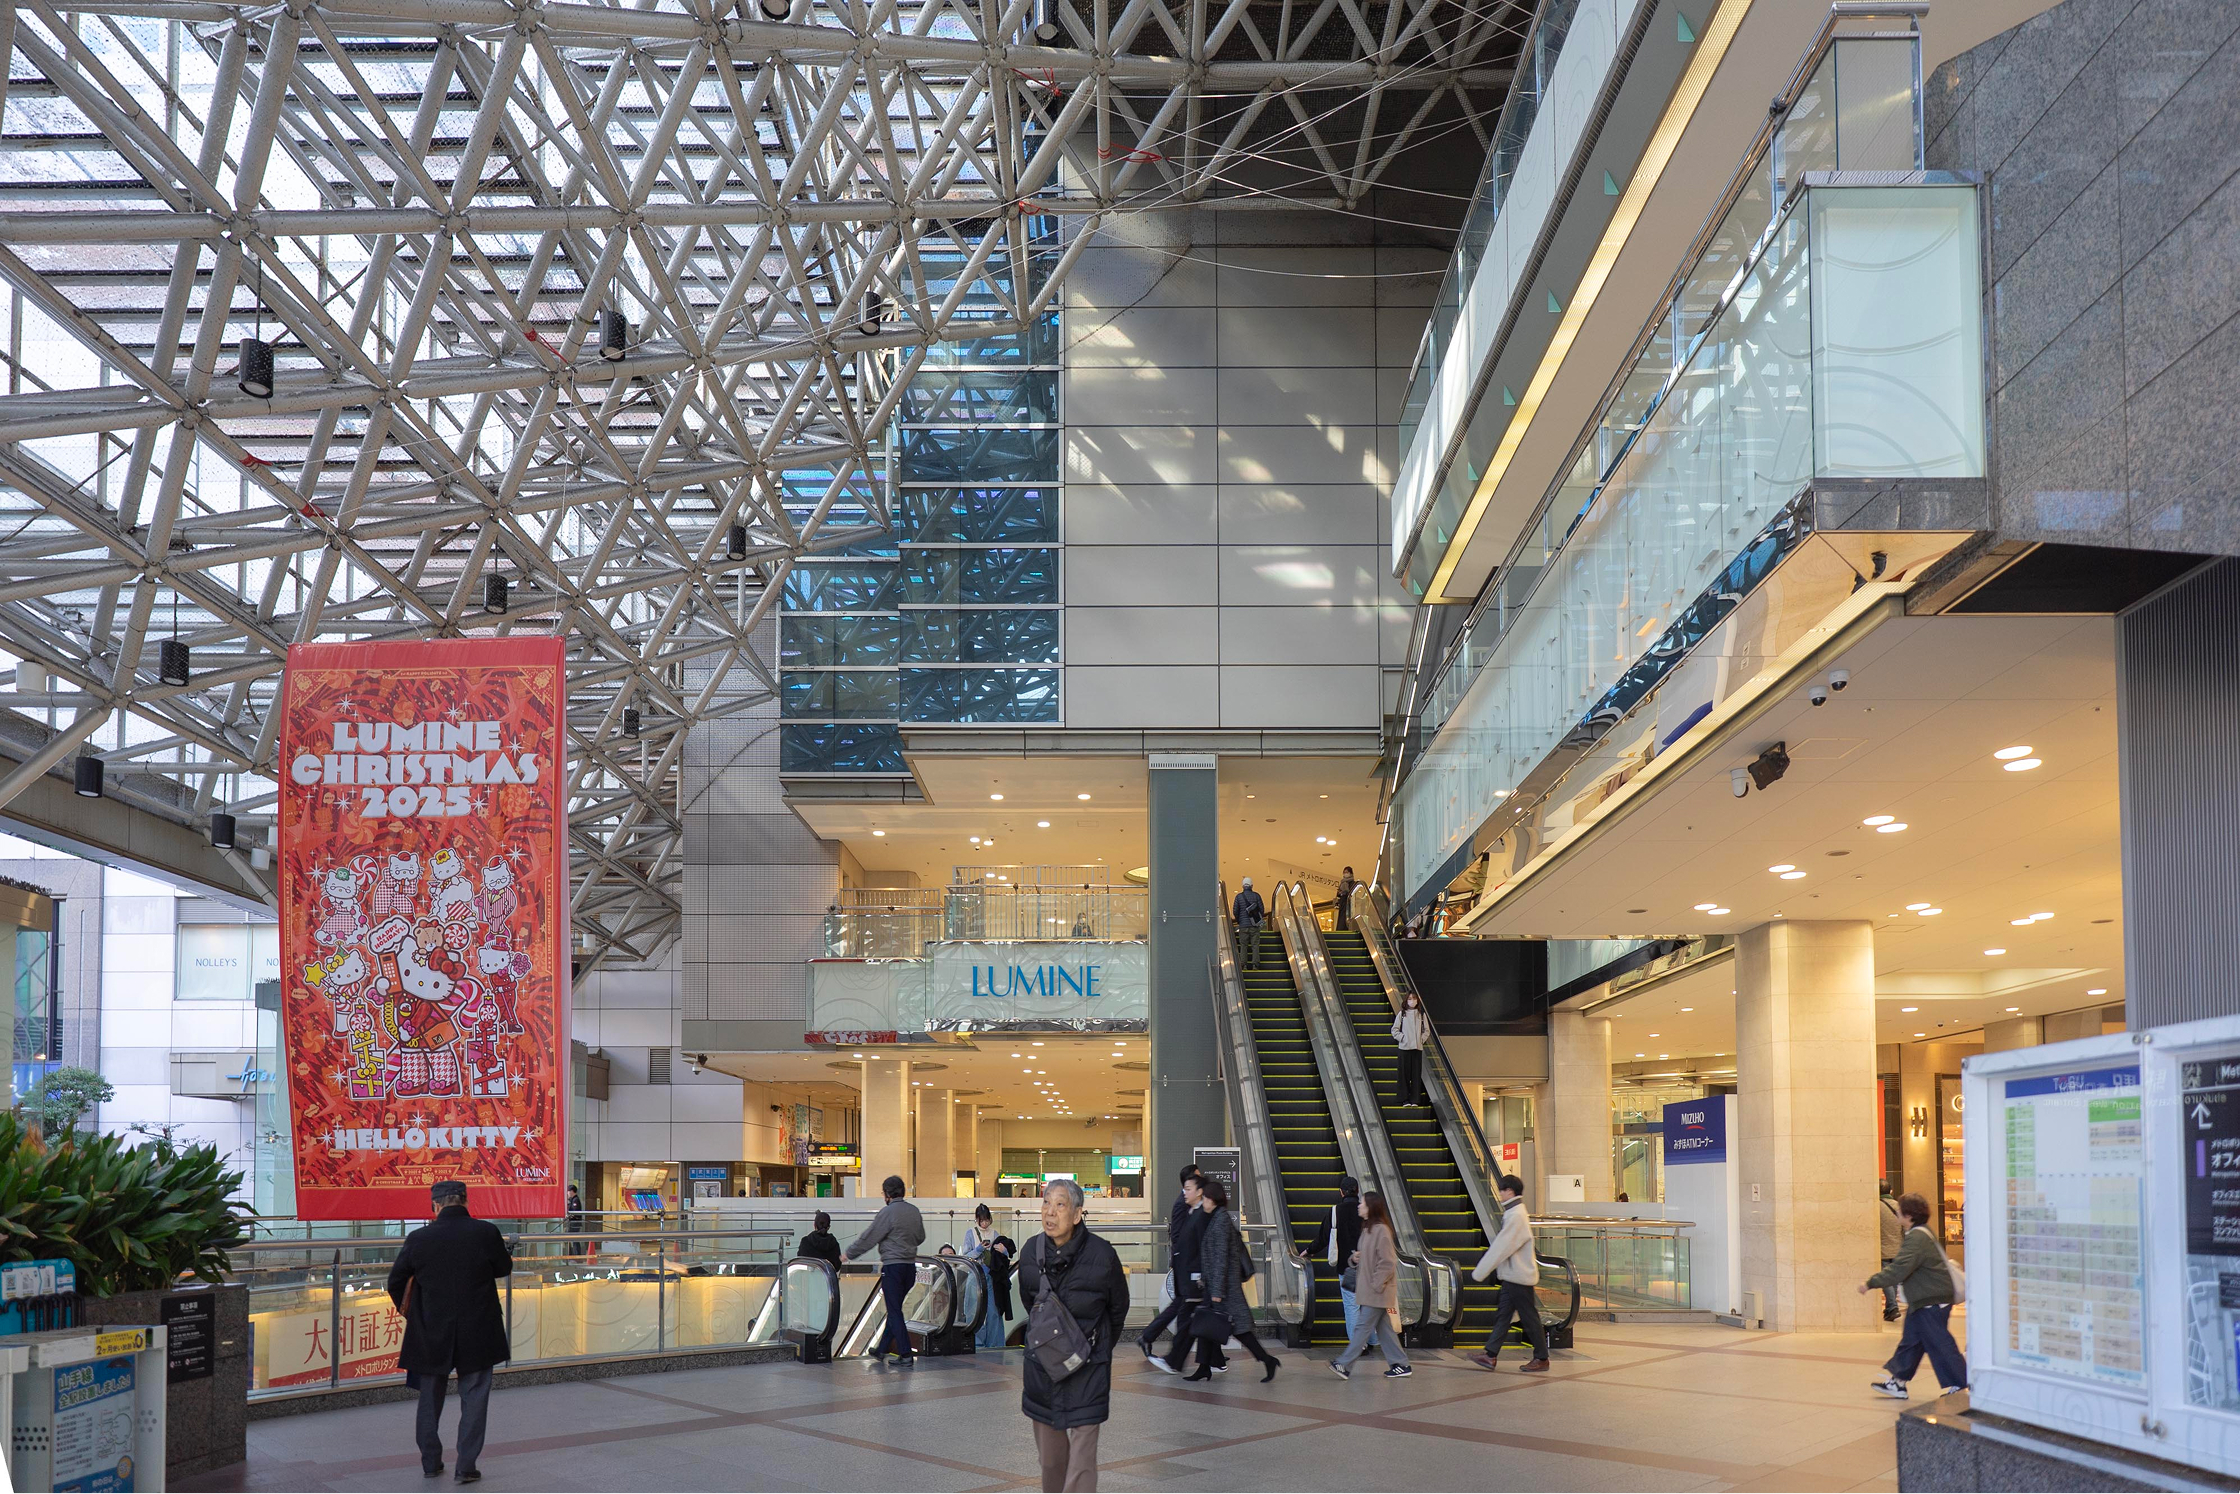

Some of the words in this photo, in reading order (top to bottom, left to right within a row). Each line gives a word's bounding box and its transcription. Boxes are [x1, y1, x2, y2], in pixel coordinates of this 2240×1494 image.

[332, 720, 502, 752] LUMINE
[291, 752, 539, 785] CHRISTMAS
[360, 786, 472, 818] 2025
[376, 923, 399, 942] HAPPY
[195, 958, 238, 967] NOLLEY'S
[972, 965, 1101, 997] LUMINE
[1680, 1111, 1705, 1125] MIZUHO
[334, 1127, 426, 1150] HELLO
[427, 1126, 522, 1149] KITTY
[1673, 1136, 1714, 1150] みずほATMコーナー
[516, 1167, 550, 1177] LUMINE
[1574, 1179, 1582, 1188] A
[303, 1306, 403, 1365] 大和証券
[58, 1366, 95, 1392] 山手線
